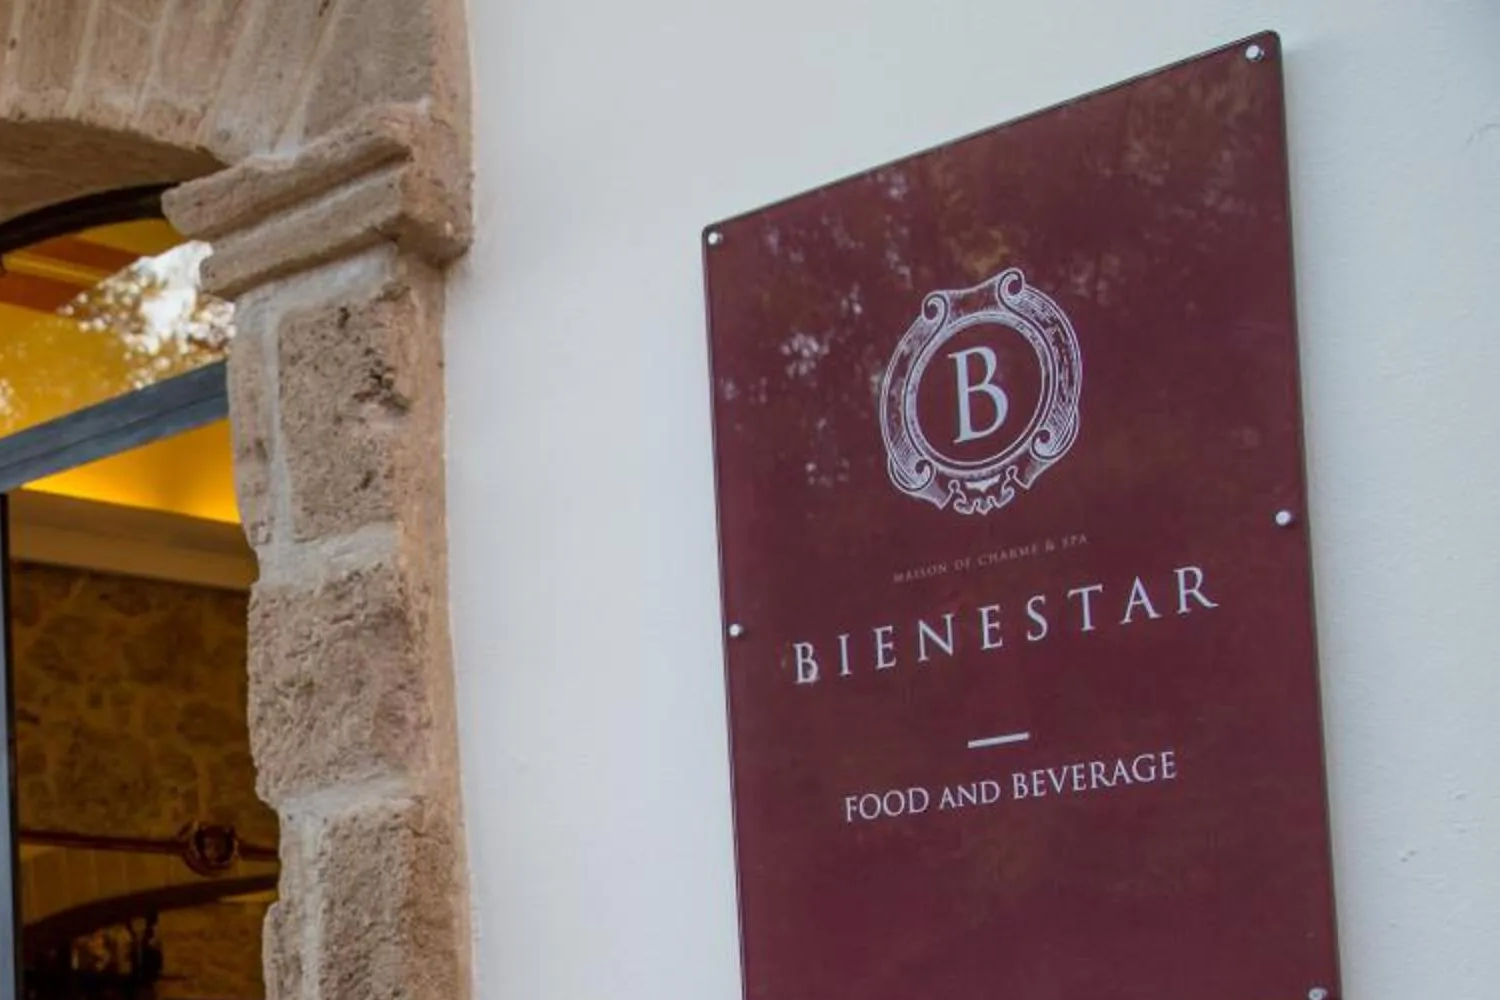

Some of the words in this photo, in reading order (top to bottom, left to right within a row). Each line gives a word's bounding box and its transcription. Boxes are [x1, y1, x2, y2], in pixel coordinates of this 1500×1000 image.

[947, 345, 1009, 445] B
[792, 565, 1220, 684] BIENESTAR
[844, 786, 930, 823] FOOD
[938, 780, 1001, 810] AND
[1011, 751, 1178, 800] BEVERAGE
